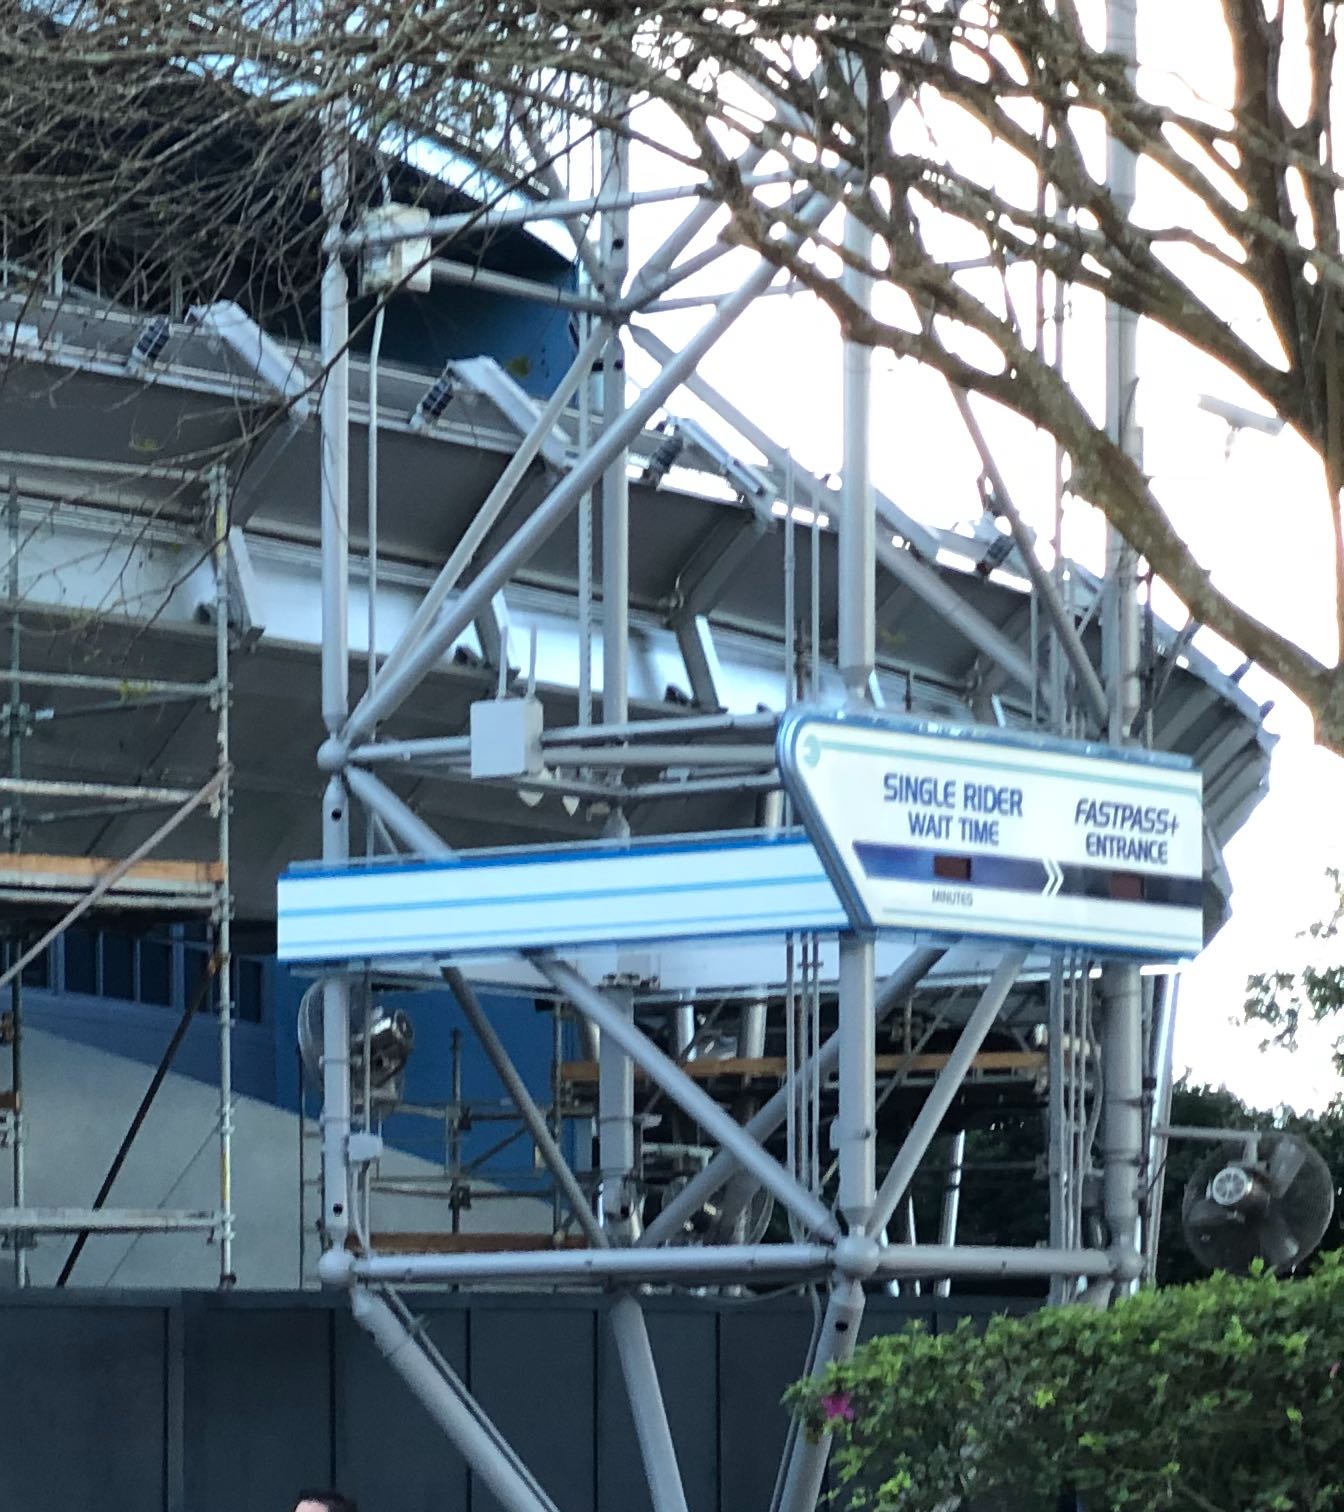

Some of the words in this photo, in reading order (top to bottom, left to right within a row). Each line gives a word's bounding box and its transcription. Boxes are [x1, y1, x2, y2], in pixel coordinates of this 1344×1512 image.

[883, 773, 956, 808] SINGLE
[963, 783, 1023, 817] RIDER
[908, 811, 952, 839] WAIT
[958, 818, 999, 846] TIME
[1074, 798, 1179, 835] FASTPASS+
[1086, 832, 1168, 864] ENTRANCE
